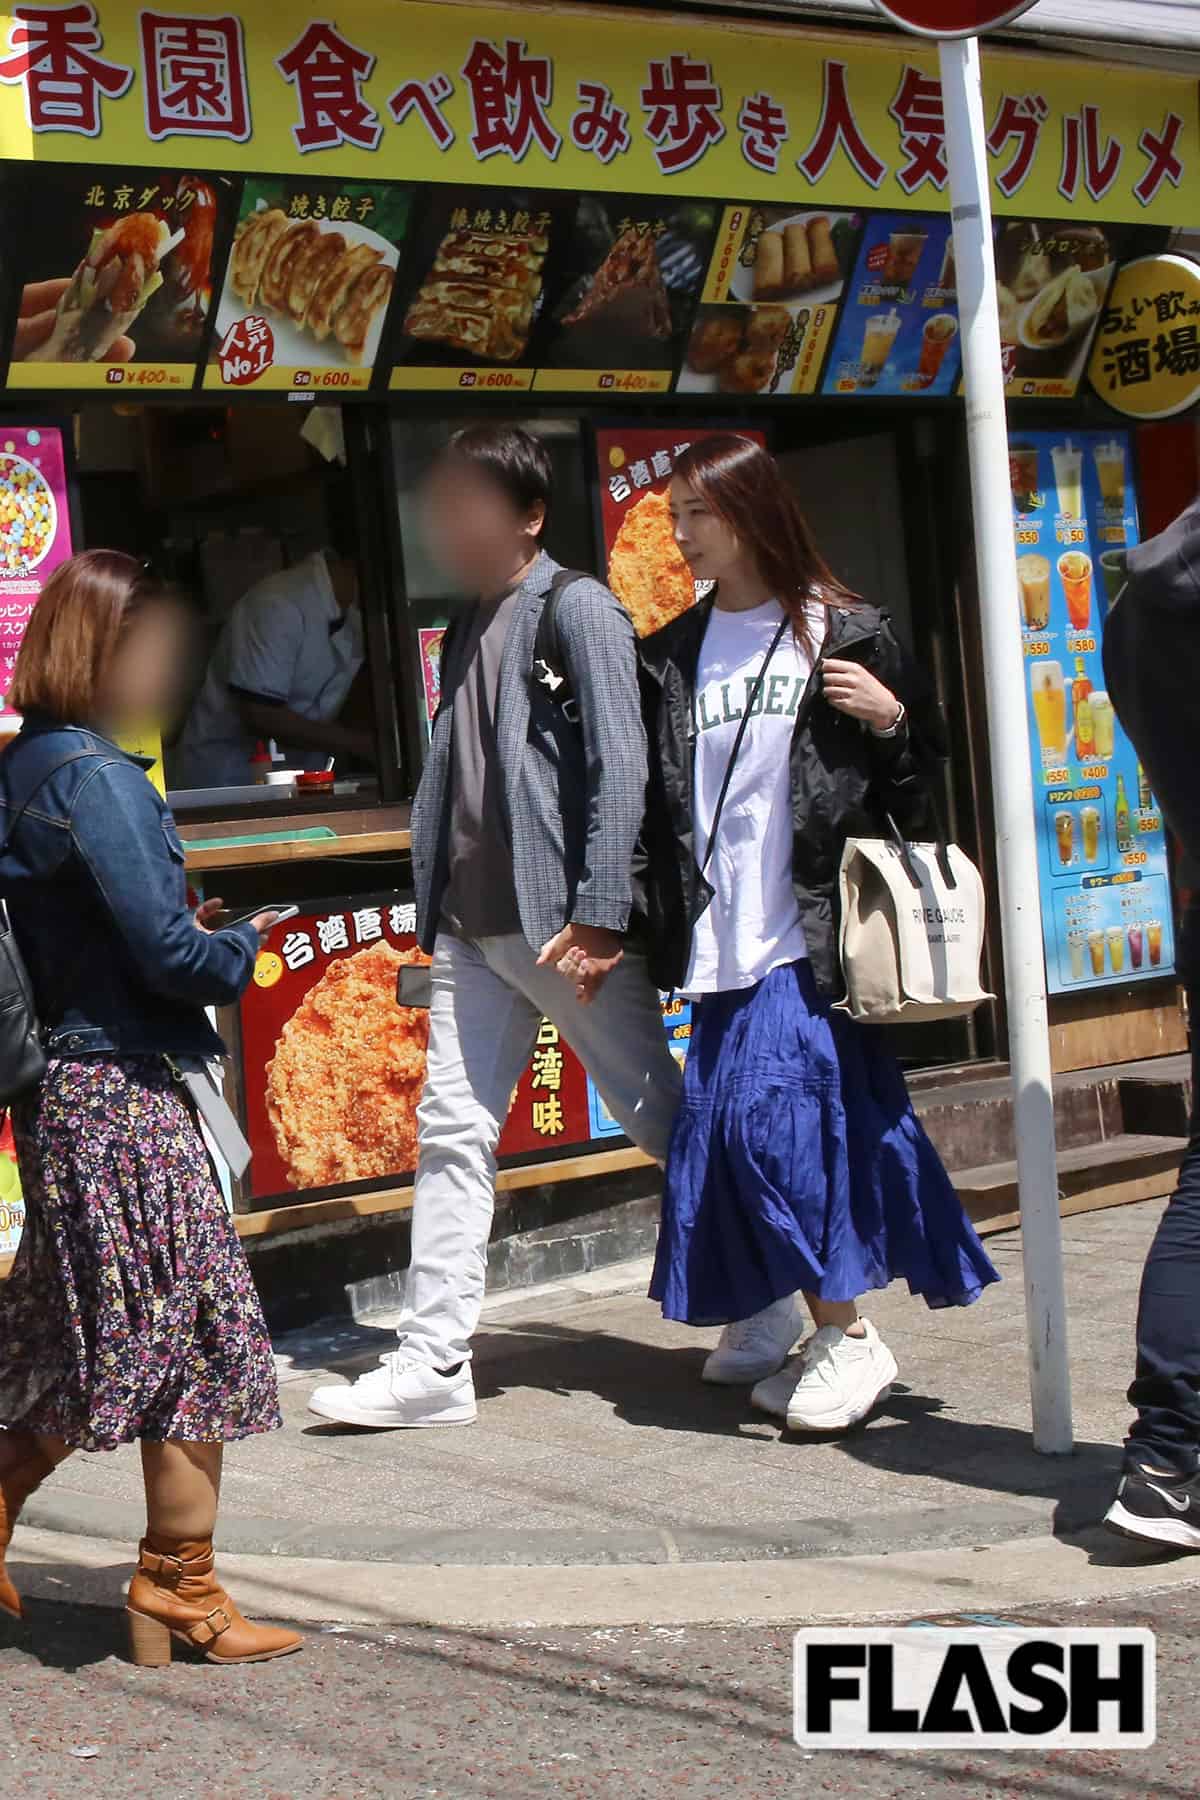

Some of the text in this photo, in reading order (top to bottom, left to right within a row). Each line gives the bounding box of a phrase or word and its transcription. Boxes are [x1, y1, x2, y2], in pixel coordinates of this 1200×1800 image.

[85, 184, 197, 211] 北京ダック
[289, 193, 375, 220] 焼き餃子
[1104, 325, 1200, 390] 酒場
[313, 372, 351, 386] ¥600
[1082, 765, 1108, 780] ¥400
[282, 903, 416, 970] 台湾唐揚
